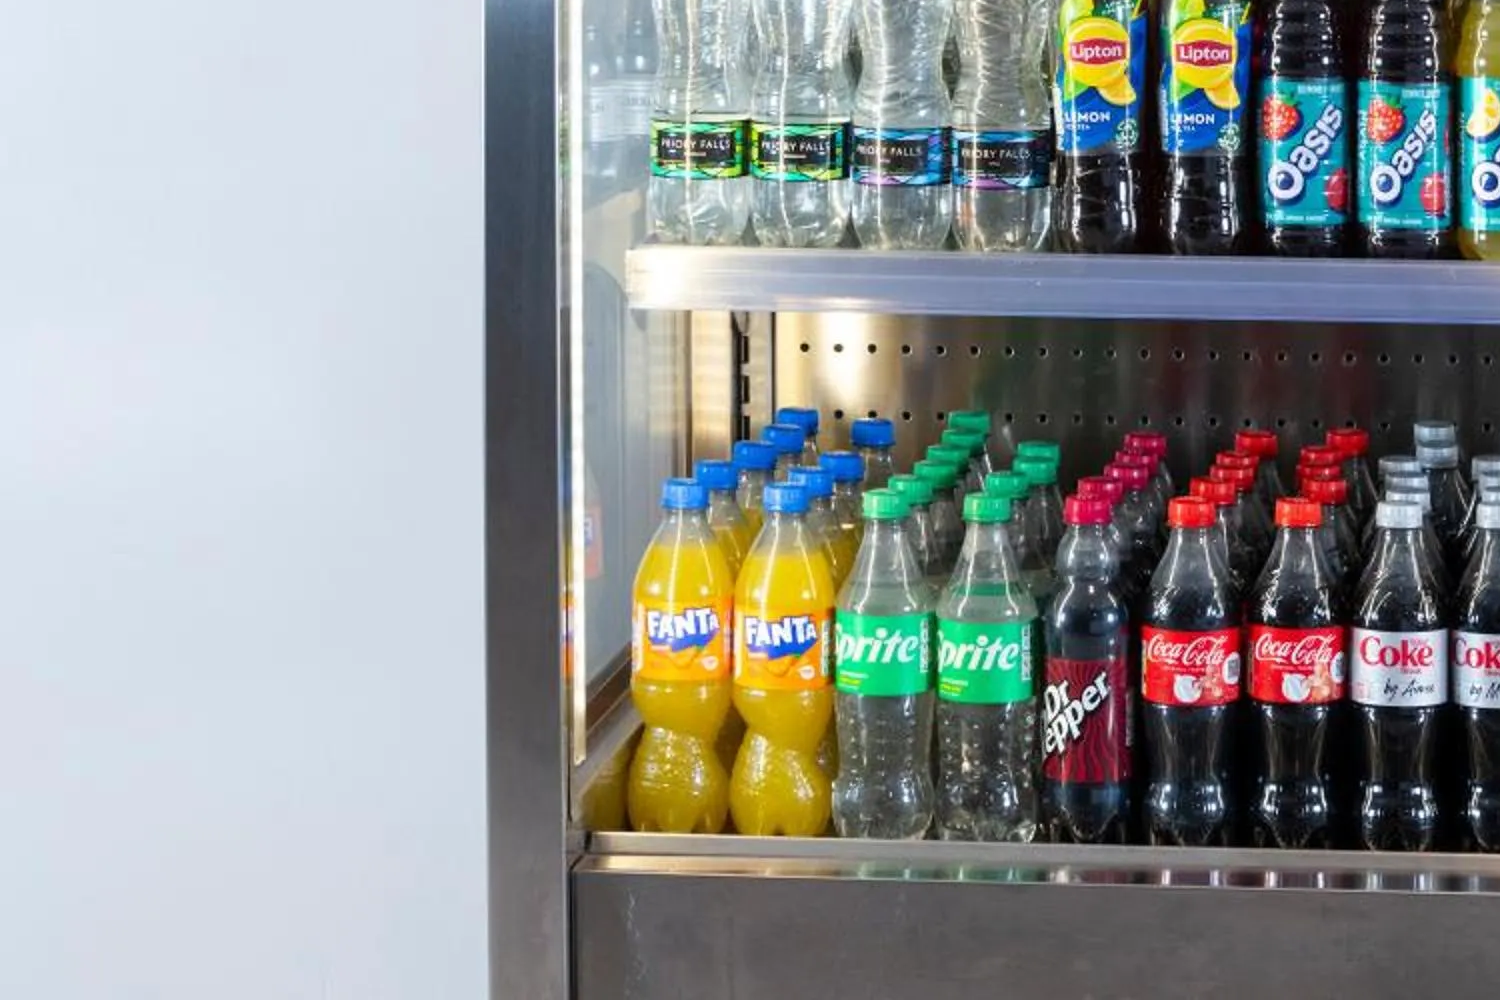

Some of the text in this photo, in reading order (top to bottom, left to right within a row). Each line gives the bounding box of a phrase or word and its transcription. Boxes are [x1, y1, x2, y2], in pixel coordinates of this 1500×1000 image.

[1071, 44, 1123, 62] Lipton
[1179, 45, 1230, 64] Lipton
[699, 139, 731, 150] FALLS
[799, 141, 831, 152] FALLS
[891, 146, 922, 157] FALLS
[999, 148, 1031, 160] FALLS
[1268, 103, 1343, 200] Oasis
[1370, 108, 1437, 203] Oasis
[647, 607, 720, 639] FANTA
[744, 616, 817, 647] FANTA
[836, 622, 919, 666] prite
[938, 630, 1019, 673] prite
[1148, 633, 1229, 666] Coca-Cola
[1255, 633, 1336, 665] Coca-Cola
[1359, 635, 1433, 668] Coke
[1043, 680, 1069, 724] Dr
